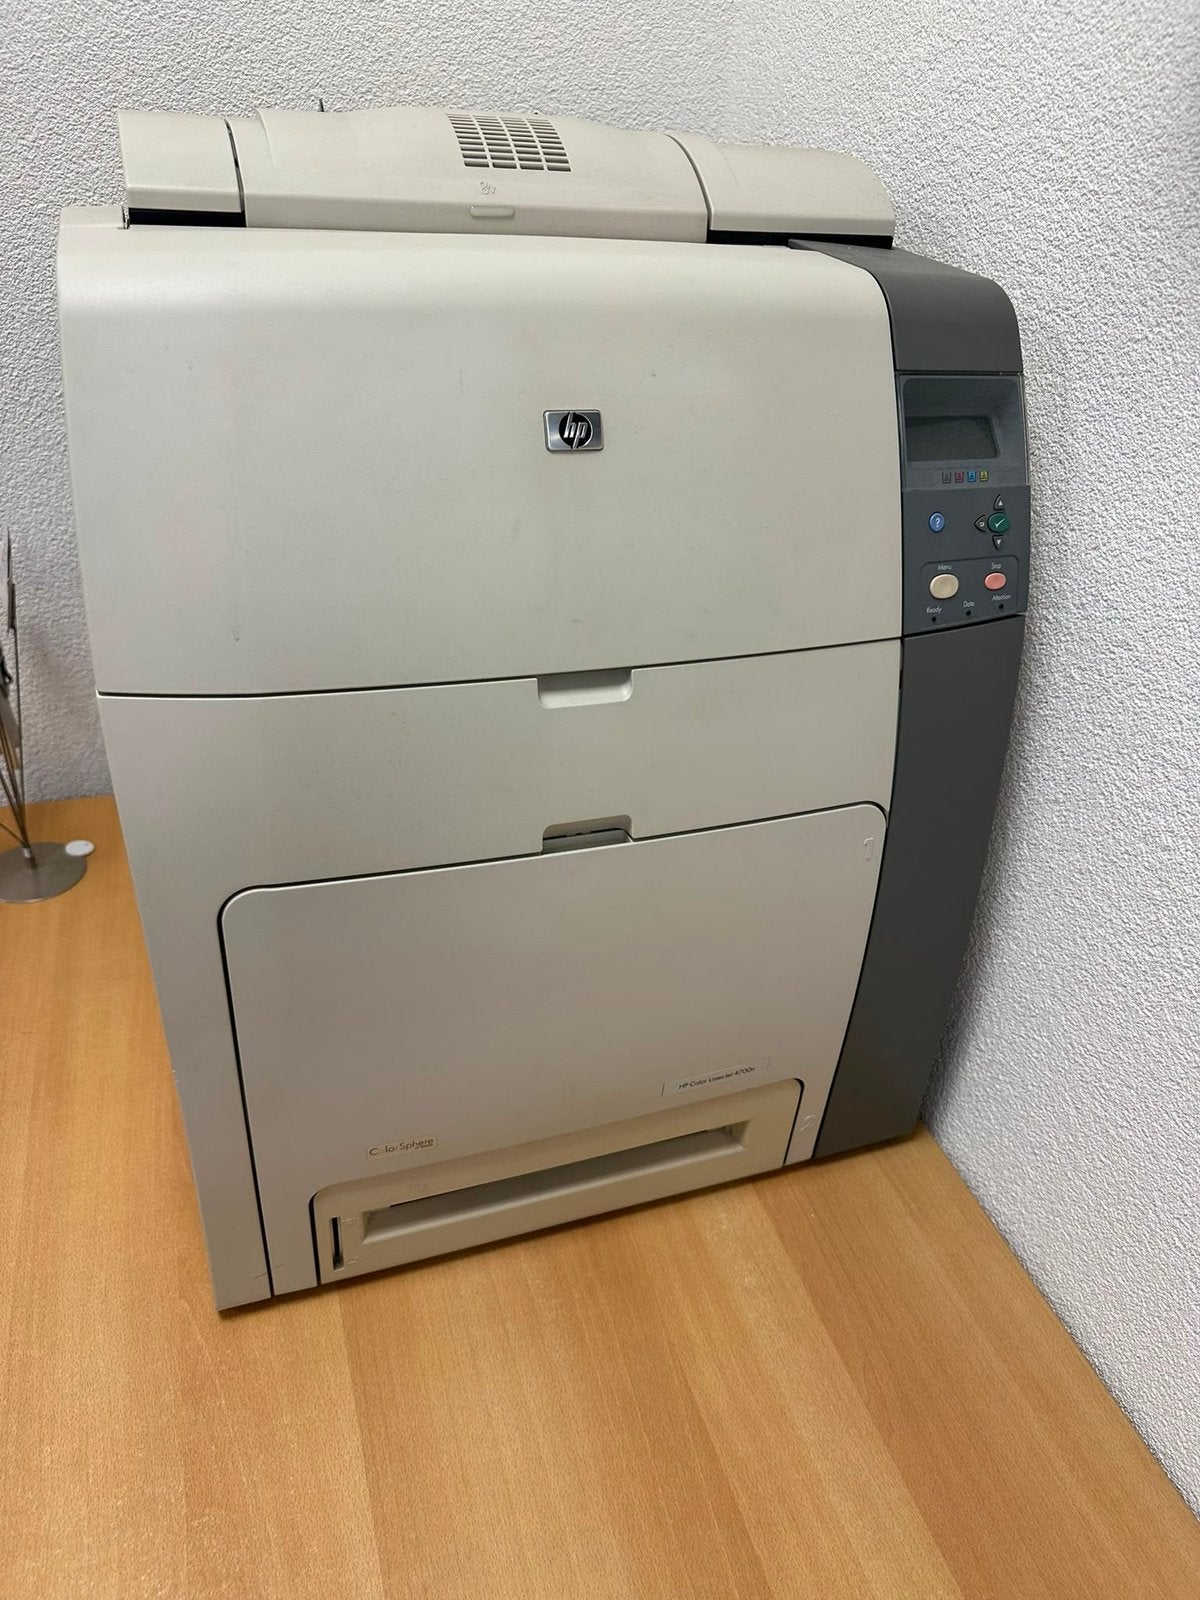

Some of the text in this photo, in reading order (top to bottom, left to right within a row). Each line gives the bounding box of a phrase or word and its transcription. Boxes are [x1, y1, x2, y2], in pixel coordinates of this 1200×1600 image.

[563, 413, 589, 449] hp
[991, 562, 1002, 570] Stop
[963, 600, 975, 608] Data
[926, 606, 942, 615] Ready
[678, 1082, 689, 1090] HP
[689, 1079, 708, 1087] Color
